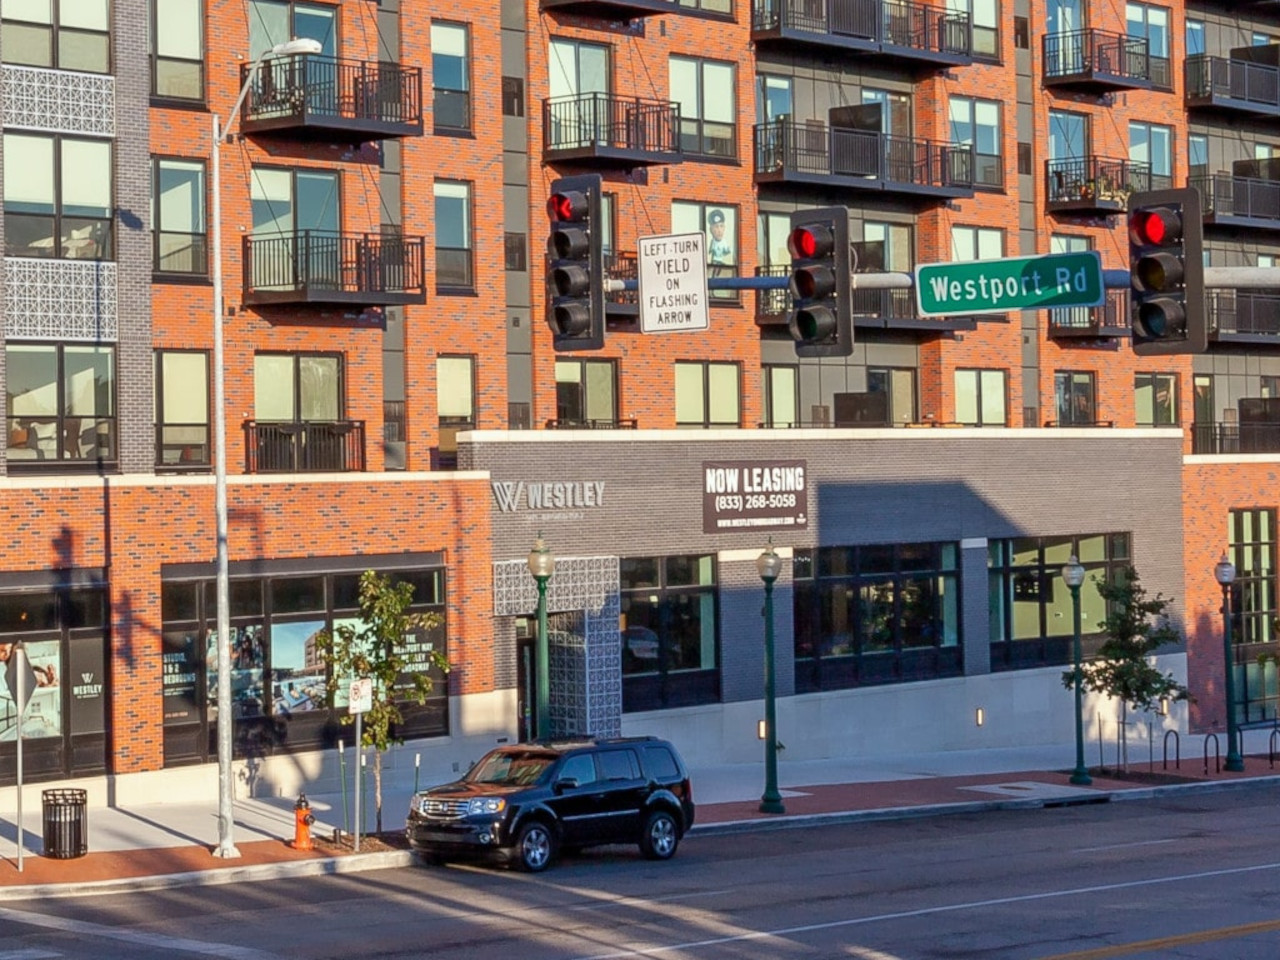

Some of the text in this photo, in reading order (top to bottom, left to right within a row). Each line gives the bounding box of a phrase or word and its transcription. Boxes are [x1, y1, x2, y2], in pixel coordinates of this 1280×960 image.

[644, 240, 699, 257] LEFT TURN
[655, 258, 690, 275] YIELD
[666, 278, 680, 290] ON
[929, 266, 1087, 305] Westport Rd
[649, 293, 699, 308] FLASHING
[657, 311, 692, 324] ARROW
[706, 467, 804, 493] NOW LEASING
[527, 481, 605, 509] WESTLEY
[715, 494, 796, 512] (833) 268-5058
[73, 684, 102, 696] WESTLEY
